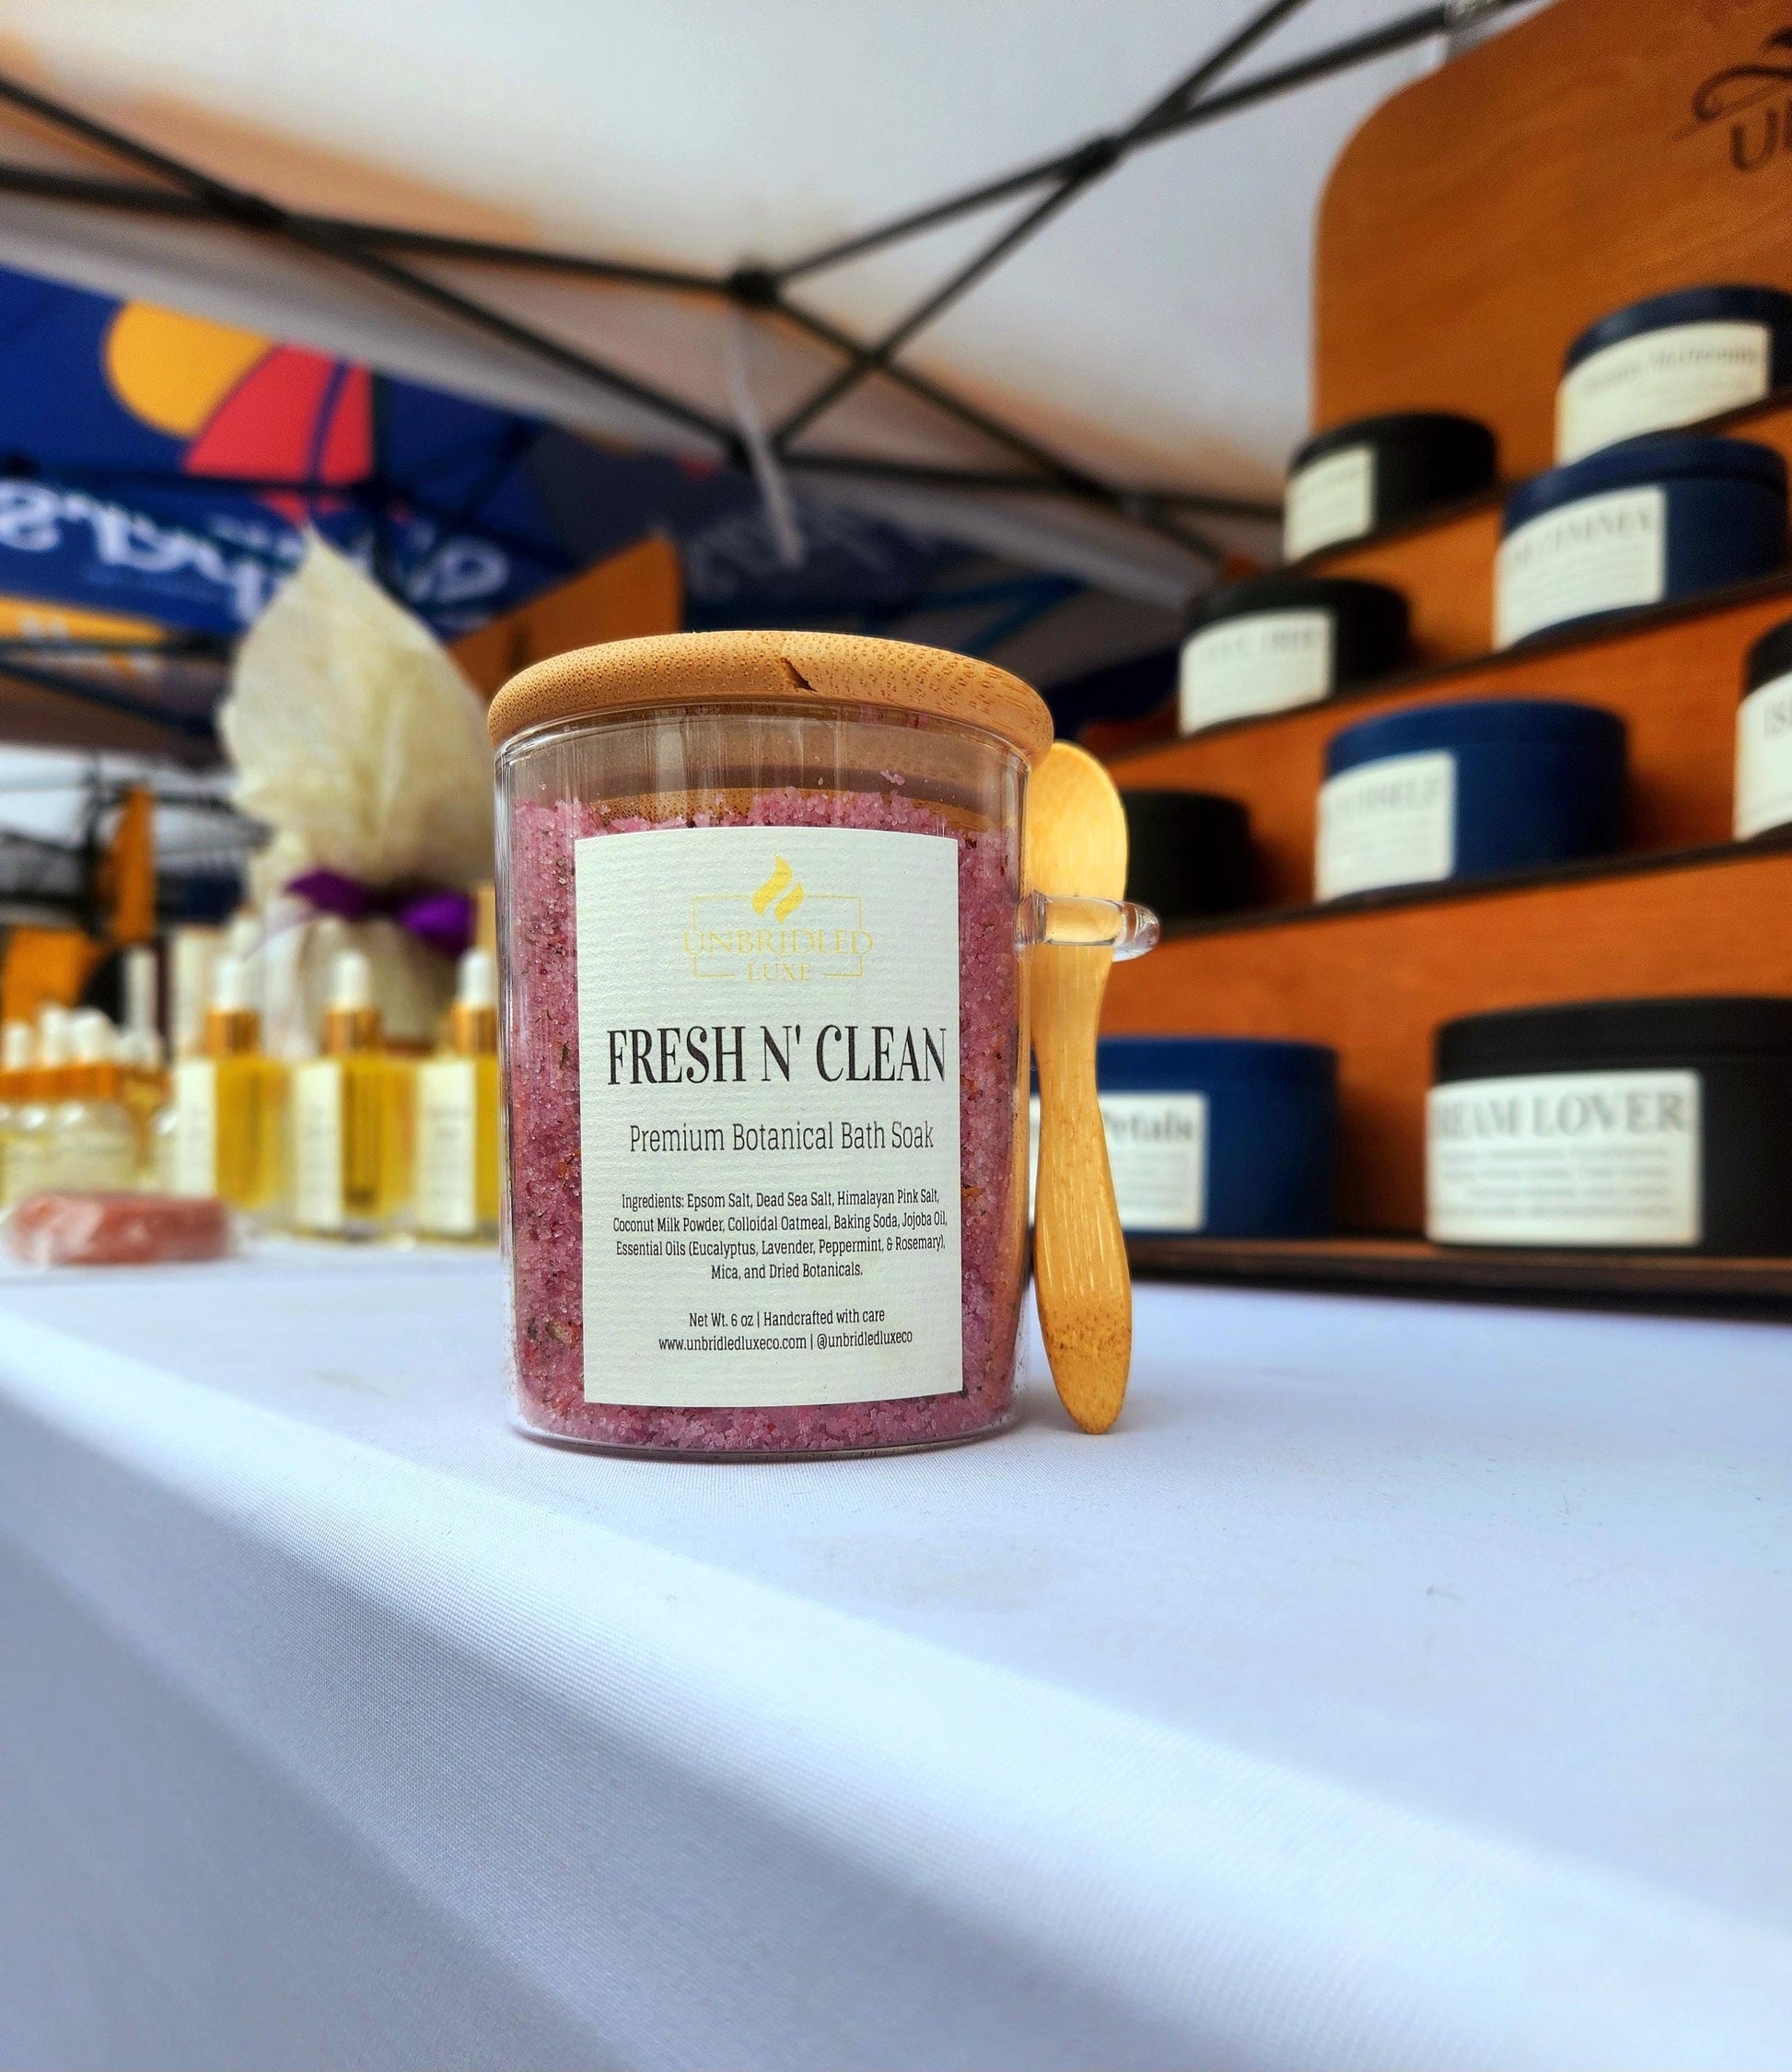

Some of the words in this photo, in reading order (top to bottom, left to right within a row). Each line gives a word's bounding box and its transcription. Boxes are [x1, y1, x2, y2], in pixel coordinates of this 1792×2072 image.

[682, 928, 874, 958] UNBRIDLED
[747, 963, 811, 982] LUXE
[607, 1026, 747, 1085] FRESH
[760, 1024, 800, 1082] N'
[816, 1024, 947, 1082] CLEAN
[1530, 1088, 1689, 1138] LOVER
[630, 1123, 725, 1152] Premium
[732, 1121, 833, 1150] Botanical
[841, 1121, 886, 1149] Bath
[892, 1121, 934, 1148] Soak
[623, 1193, 684, 1212] Ingredients:
[687, 1193, 725, 1212] Epsom
[728, 1193, 752, 1208] Salt,
[756, 1193, 785, 1207] Dead
[787, 1192, 808, 1206] Sea
[811, 1191, 834, 1207] Salt,
[838, 1190, 894, 1208] Himalayan
[898, 1189, 918, 1204] Pink
[921, 1188, 939, 1204] Salt,
[613, 1217, 654, 1232] Coconut
[657, 1216, 680, 1231] Milk
[683, 1217, 725, 1232] Powder,
[728, 1216, 777, 1231] Colloidal
[781, 1215, 831, 1230] Oatmeal,
[834, 1214, 870, 1232] Baking
[873, 1213, 900, 1228] Soda,
[902, 1212, 932, 1230] Jojoba
[934, 1210, 947, 1226] Oil,
[617, 1240, 662, 1255] Essential
[666, 1240, 685, 1255] Oils
[689, 1241, 758, 1259] (Eucalyptus,
[762, 1240, 815, 1254] Lavender,
[819, 1237, 884, 1256] Peppermint,
[887, 1238, 892, 1251] &
[896, 1234, 945, 1251] Rosemary),
[711, 1263, 740, 1280] Mica,
[744, 1264, 765, 1279] and
[770, 1263, 799, 1278] Dried
[803, 1262, 863, 1277] Botanicals.
[689, 1313, 708, 1327] Net
[711, 1312, 727, 1327] Wt.
[731, 1313, 738, 1327] 6
[741, 1315, 753, 1326] oz
[763, 1310, 833, 1326] Handcrafted
[835, 1309, 859, 1323] with
[863, 1310, 885, 1322] care
[658, 1335, 807, 1351] www.unbridledluxeco.com
[817, 1331, 913, 1349] @unbridledluxeco
